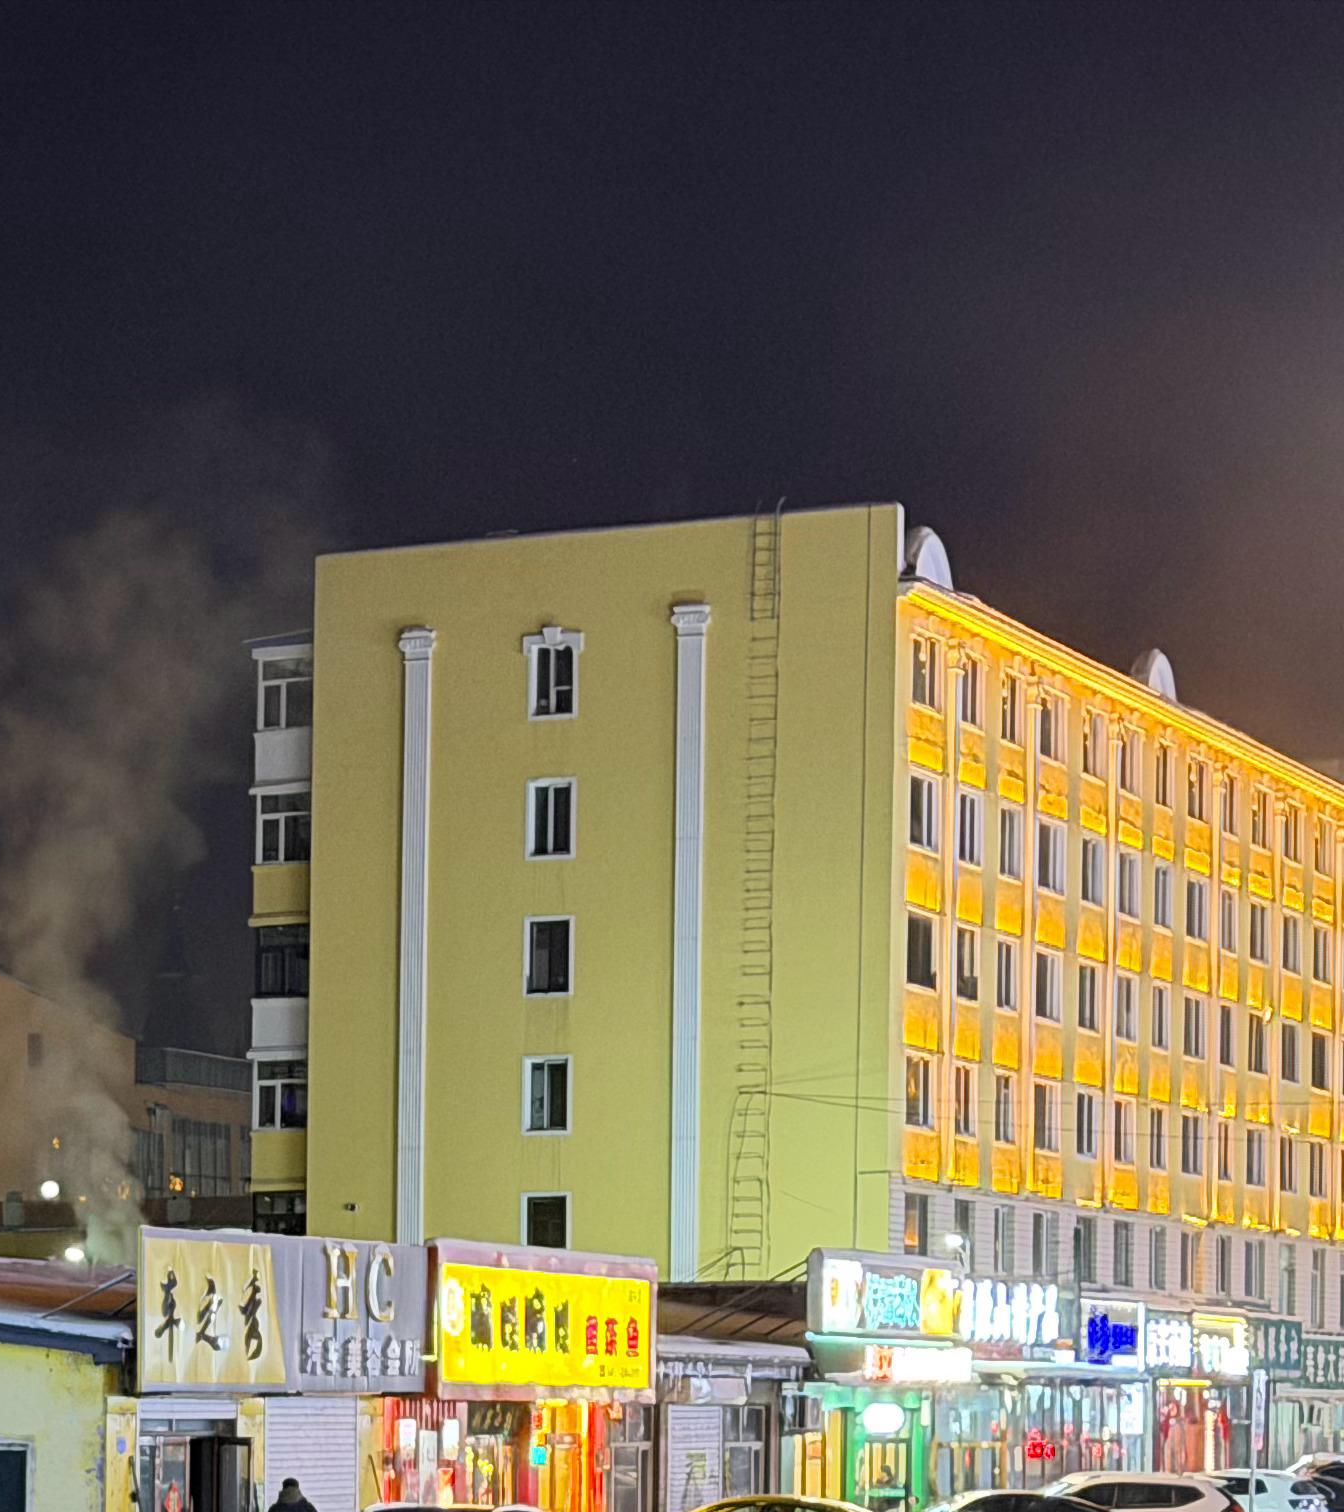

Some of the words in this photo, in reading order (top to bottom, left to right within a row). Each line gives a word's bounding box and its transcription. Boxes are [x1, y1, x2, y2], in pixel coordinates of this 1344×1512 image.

[154, 1267, 267, 1362] 车之秀
[321, 1241, 395, 1322] HC
[301, 1331, 422, 1379] 汽车美容会所
